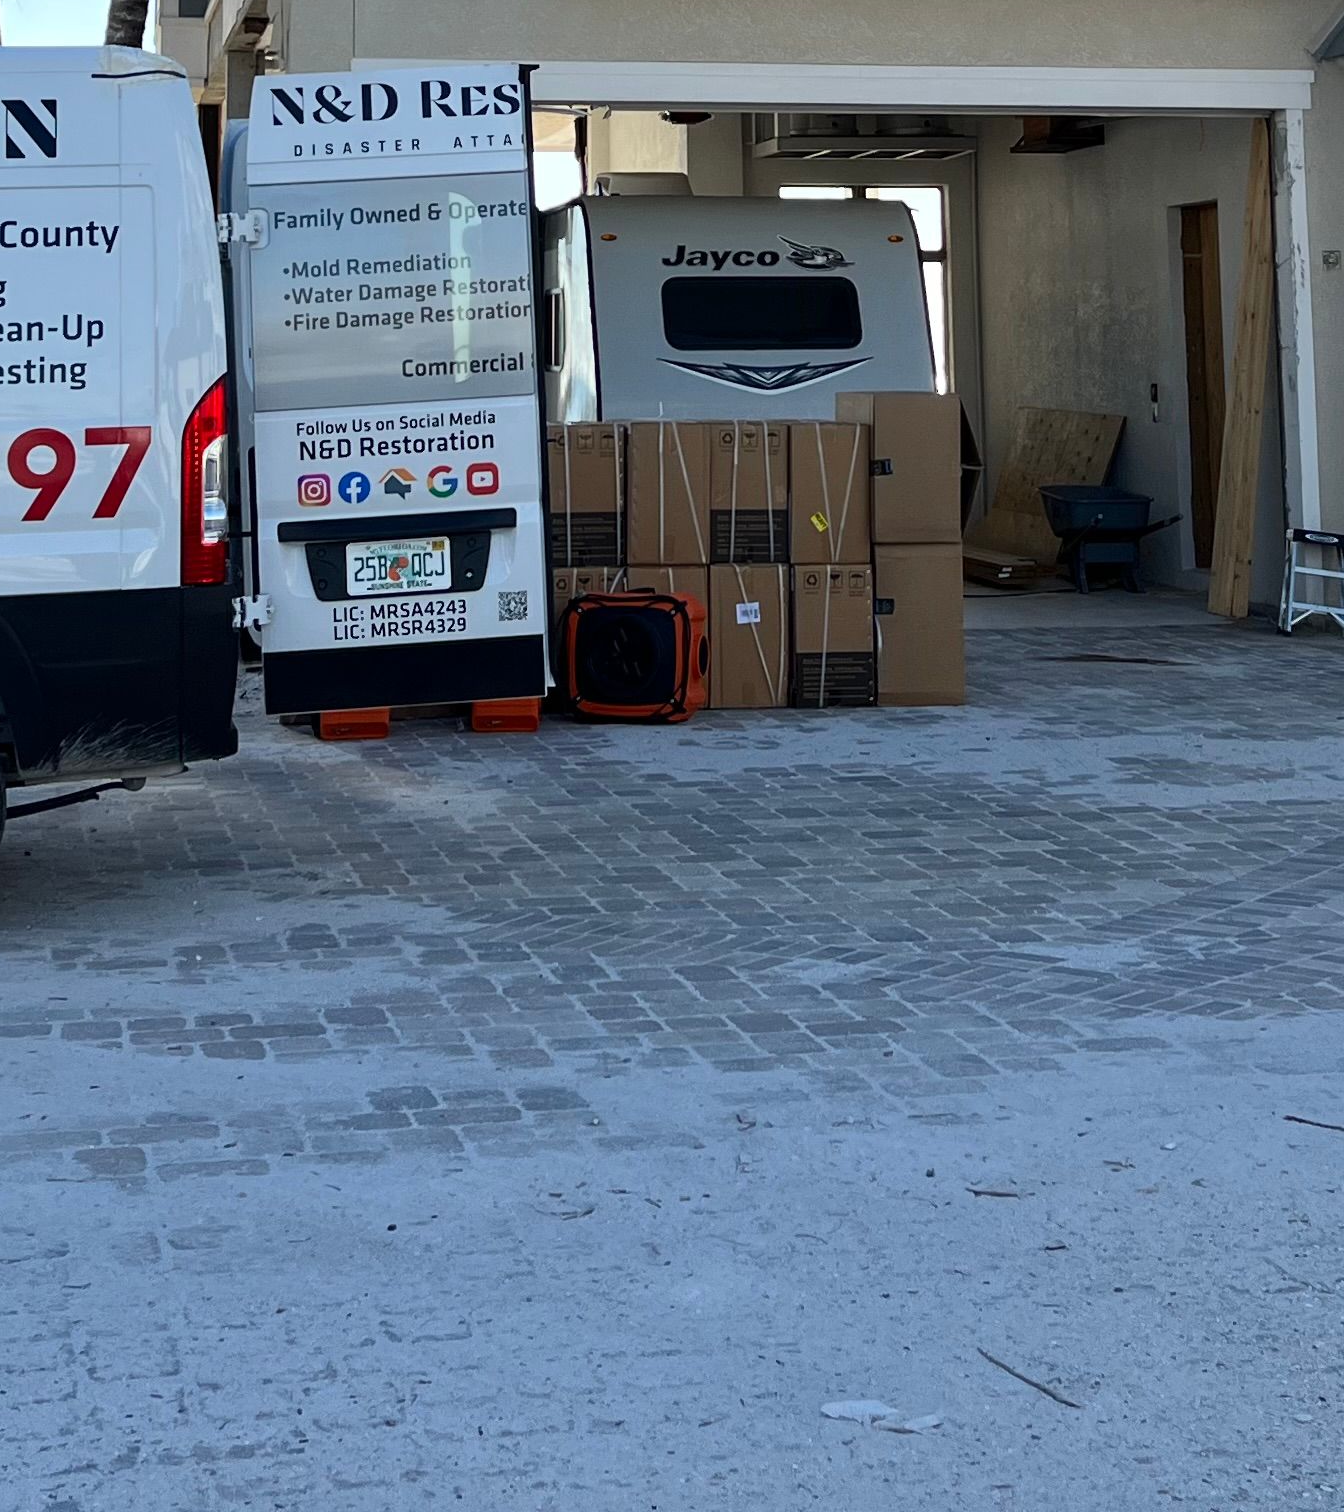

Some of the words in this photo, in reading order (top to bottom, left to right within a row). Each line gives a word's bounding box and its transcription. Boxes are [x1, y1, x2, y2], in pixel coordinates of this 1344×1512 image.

[270, 83, 398, 125] N&D
[421, 81, 520, 118] RES
[295, 139, 419, 156] DISASTER
[454, 133, 525, 148] ATTA
[274, 208, 344, 230] Family
[351, 204, 420, 224] Owned
[428, 203, 441, 220] &
[0, 221, 119, 253] County
[292, 259, 339, 278] Mold
[347, 253, 471, 275] Remediation
[662, 245, 779, 271] Jayco
[292, 287, 352, 304] Water
[359, 284, 436, 302] Damage
[294, 313, 329, 331] Fire
[337, 312, 414, 329] Damage
[402, 352, 524, 377] Commercial
[297, 421, 347, 436] Follow
[352, 419, 371, 432] Us
[376, 420, 394, 431] on
[400, 413, 444, 429] Social
[450, 410, 495, 426] Media
[300, 439, 351, 460] N&D
[360, 430, 494, 456] Restoration
[354, 555, 388, 582] 25B
[412, 550, 445, 577] QCJ
[333, 606, 364, 622] LIC:
[371, 600, 466, 620] MRSA4243
[334, 625, 365, 640] LIC:
[372, 618, 466, 637] MRSR4329
